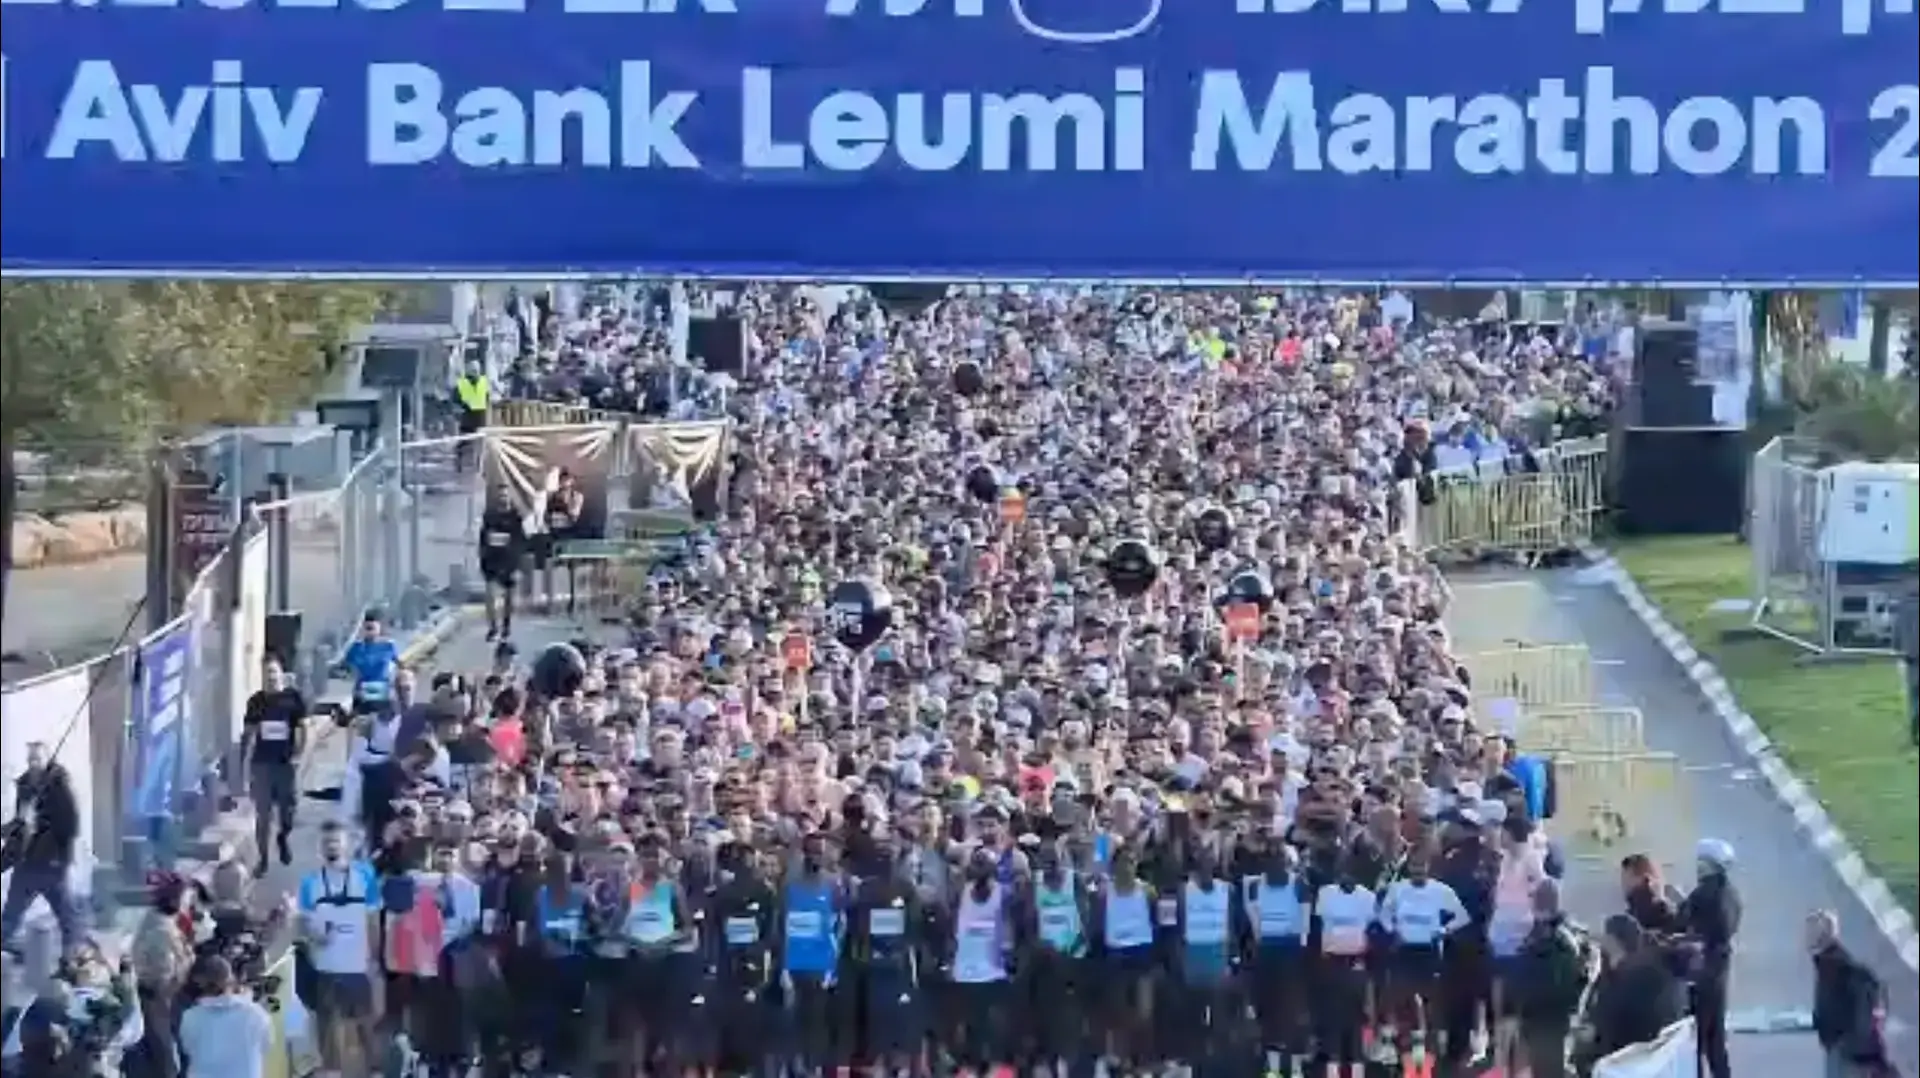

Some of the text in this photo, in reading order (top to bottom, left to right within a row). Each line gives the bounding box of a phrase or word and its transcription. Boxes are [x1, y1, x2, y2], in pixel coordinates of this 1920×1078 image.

[46, 60, 323, 162] Aviv
[367, 60, 701, 168] Bank
[742, 67, 1145, 171] Leumi
[1190, 66, 1827, 175] Marathon
